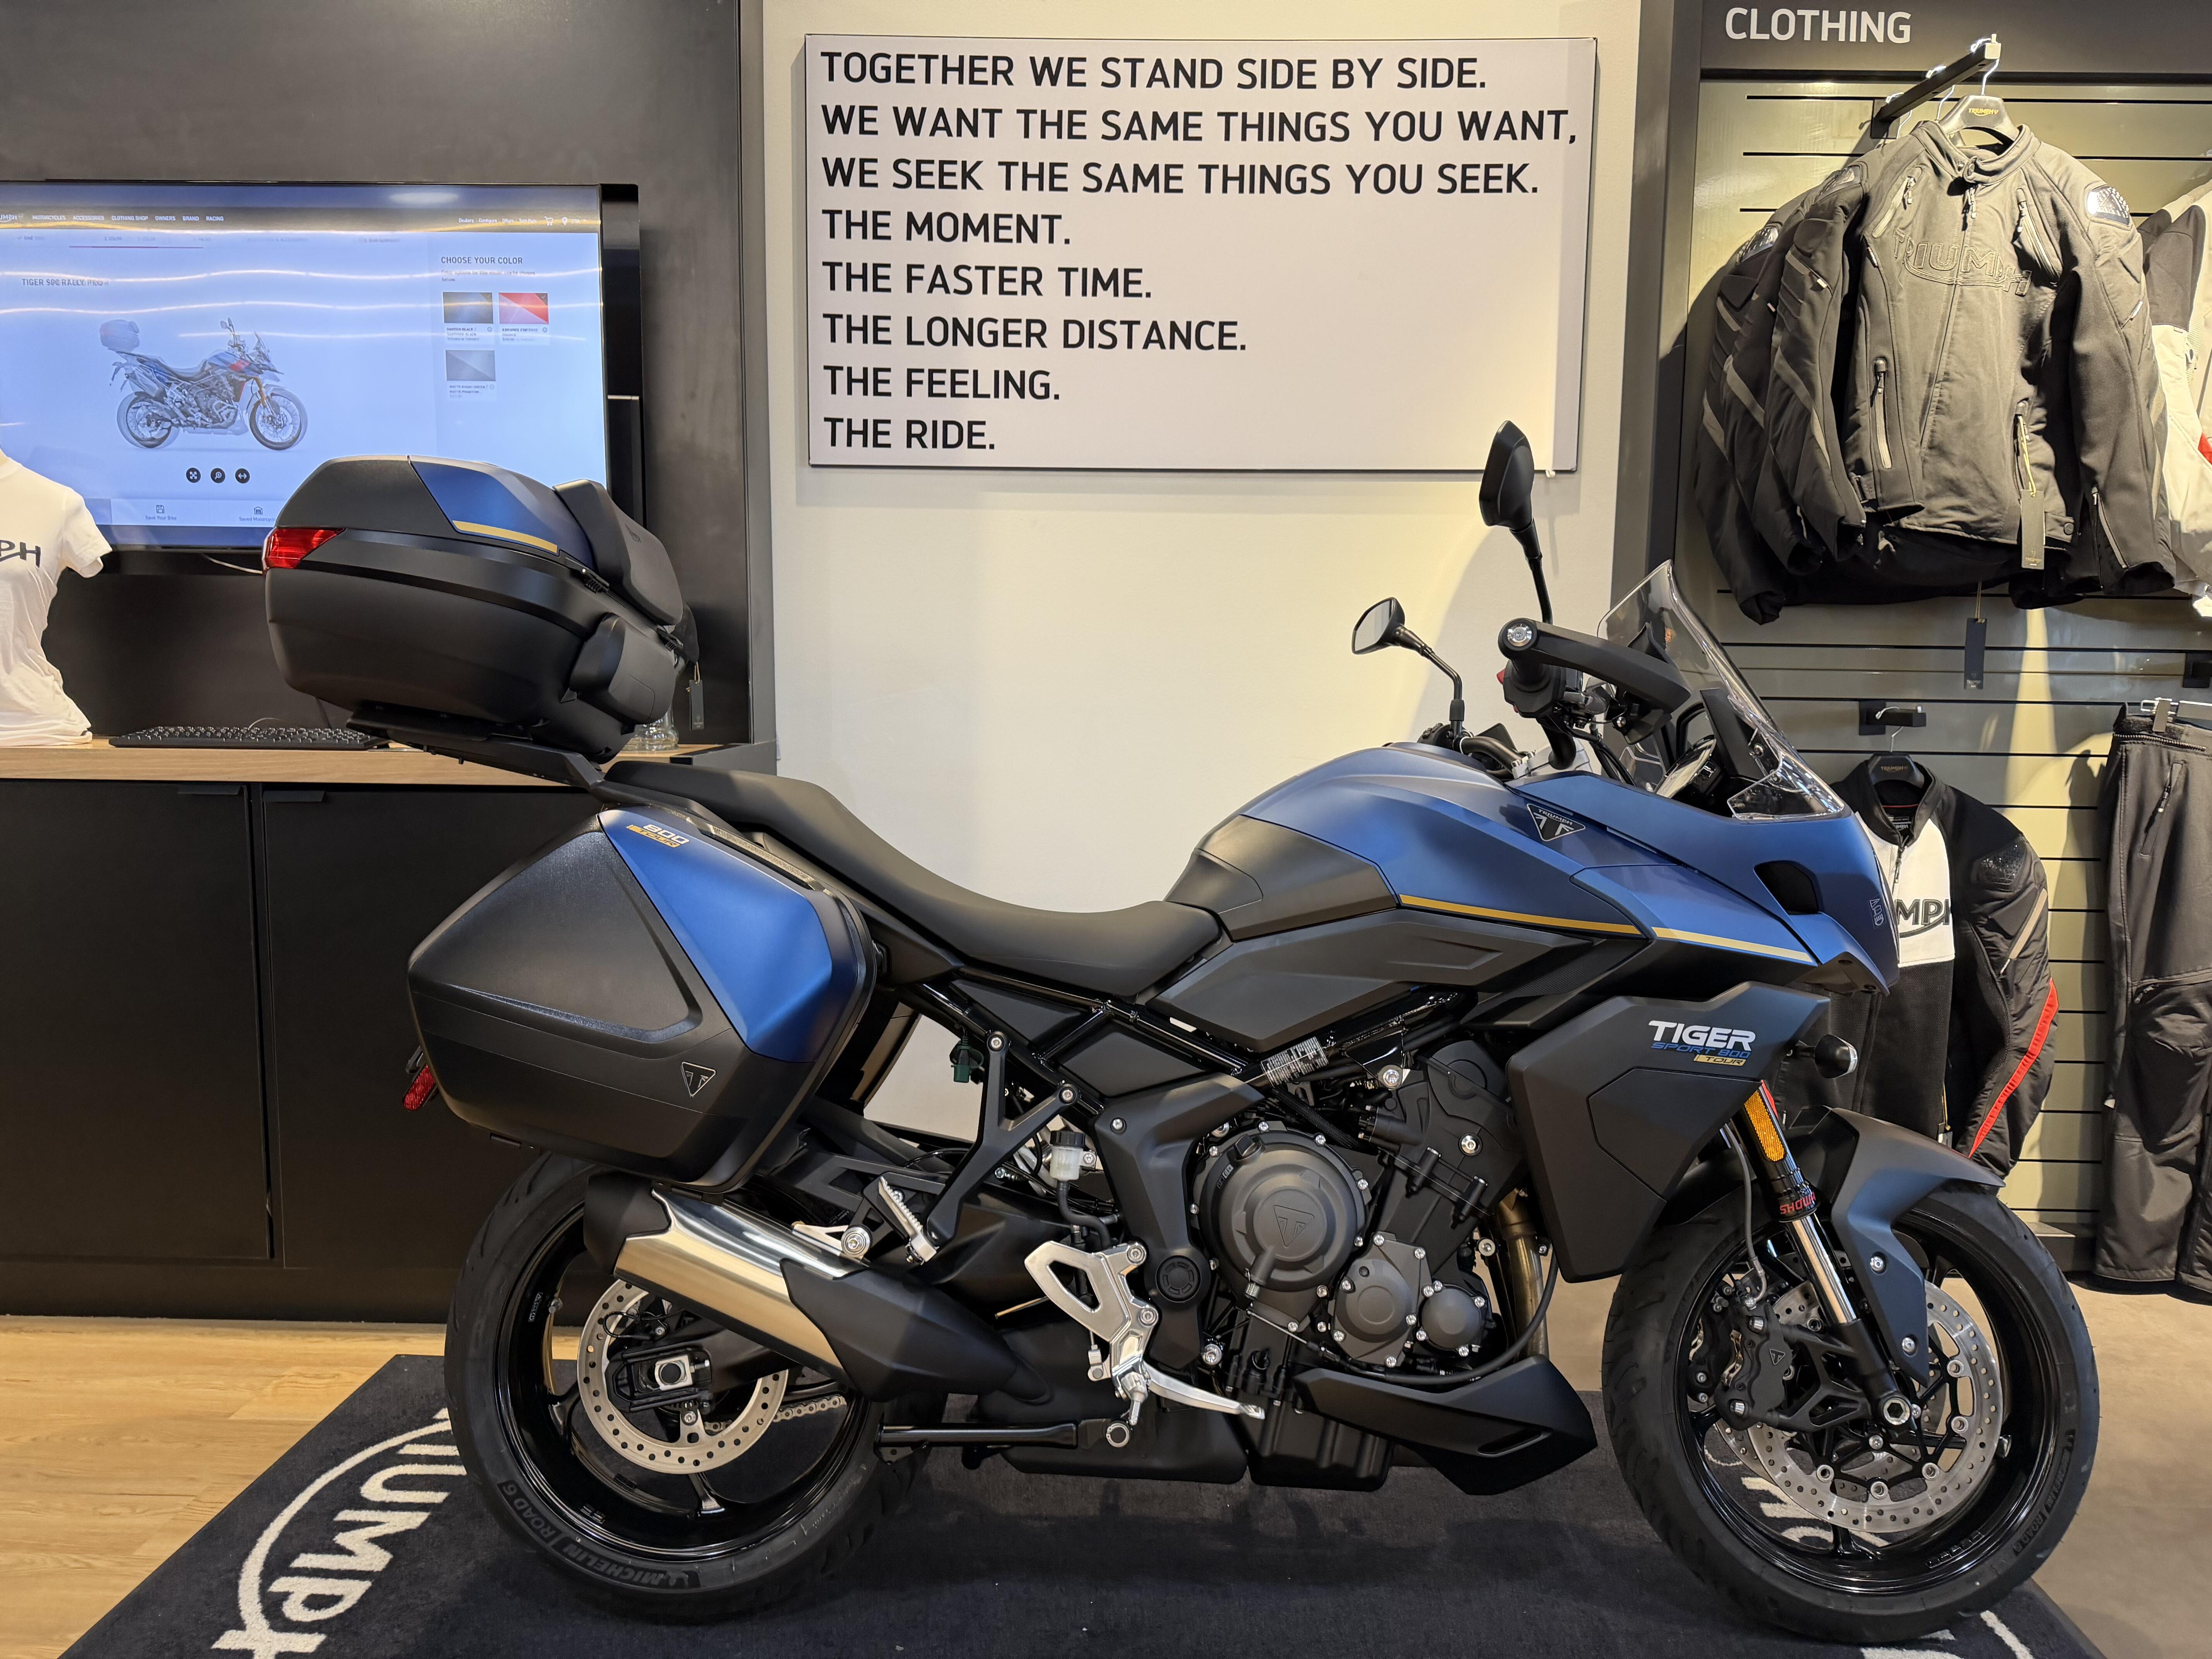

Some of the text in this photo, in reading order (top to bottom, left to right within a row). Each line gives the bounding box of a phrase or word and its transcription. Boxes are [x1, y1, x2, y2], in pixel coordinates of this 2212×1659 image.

[1725, 7, 1912, 44] CLOTHING
[821, 52, 1485, 89] TOGETHER WE STAND SIDE BY SIDE.
[821, 105, 1575, 144] WE WANT THE SAME THINGS YOU WANT,
[1968, 108, 1994, 116] TRIUMPH
[822, 158, 1537, 194] WE SEEK THE SAME THINGS YOU SEEK.
[822, 210, 1069, 244] THE MOMENT.
[498, 257, 523, 265] COLOR
[1893, 228, 2032, 297] TRIUMPH
[823, 262, 1151, 297] THE FASTER TIME.
[823, 314, 1245, 350] THE LONGER DISTANCE.
[824, 366, 1059, 399] THE FEELING.
[824, 417, 994, 449] THE RIDE.
[1538, 809, 1573, 825] TRIUMPH
[637, 829, 678, 847] TOUR
[643, 824, 689, 845] 800
[1648, 1020, 1756, 1051] TIGER
[1651, 1042, 1751, 1059] SPORT 800
[1704, 1056, 1744, 1065] TOUR
[1779, 1192, 1816, 1214] SHOWA
[502, 1483, 556, 1537] ROAD 6
[563, 1542, 661, 1586] MICHELIN
